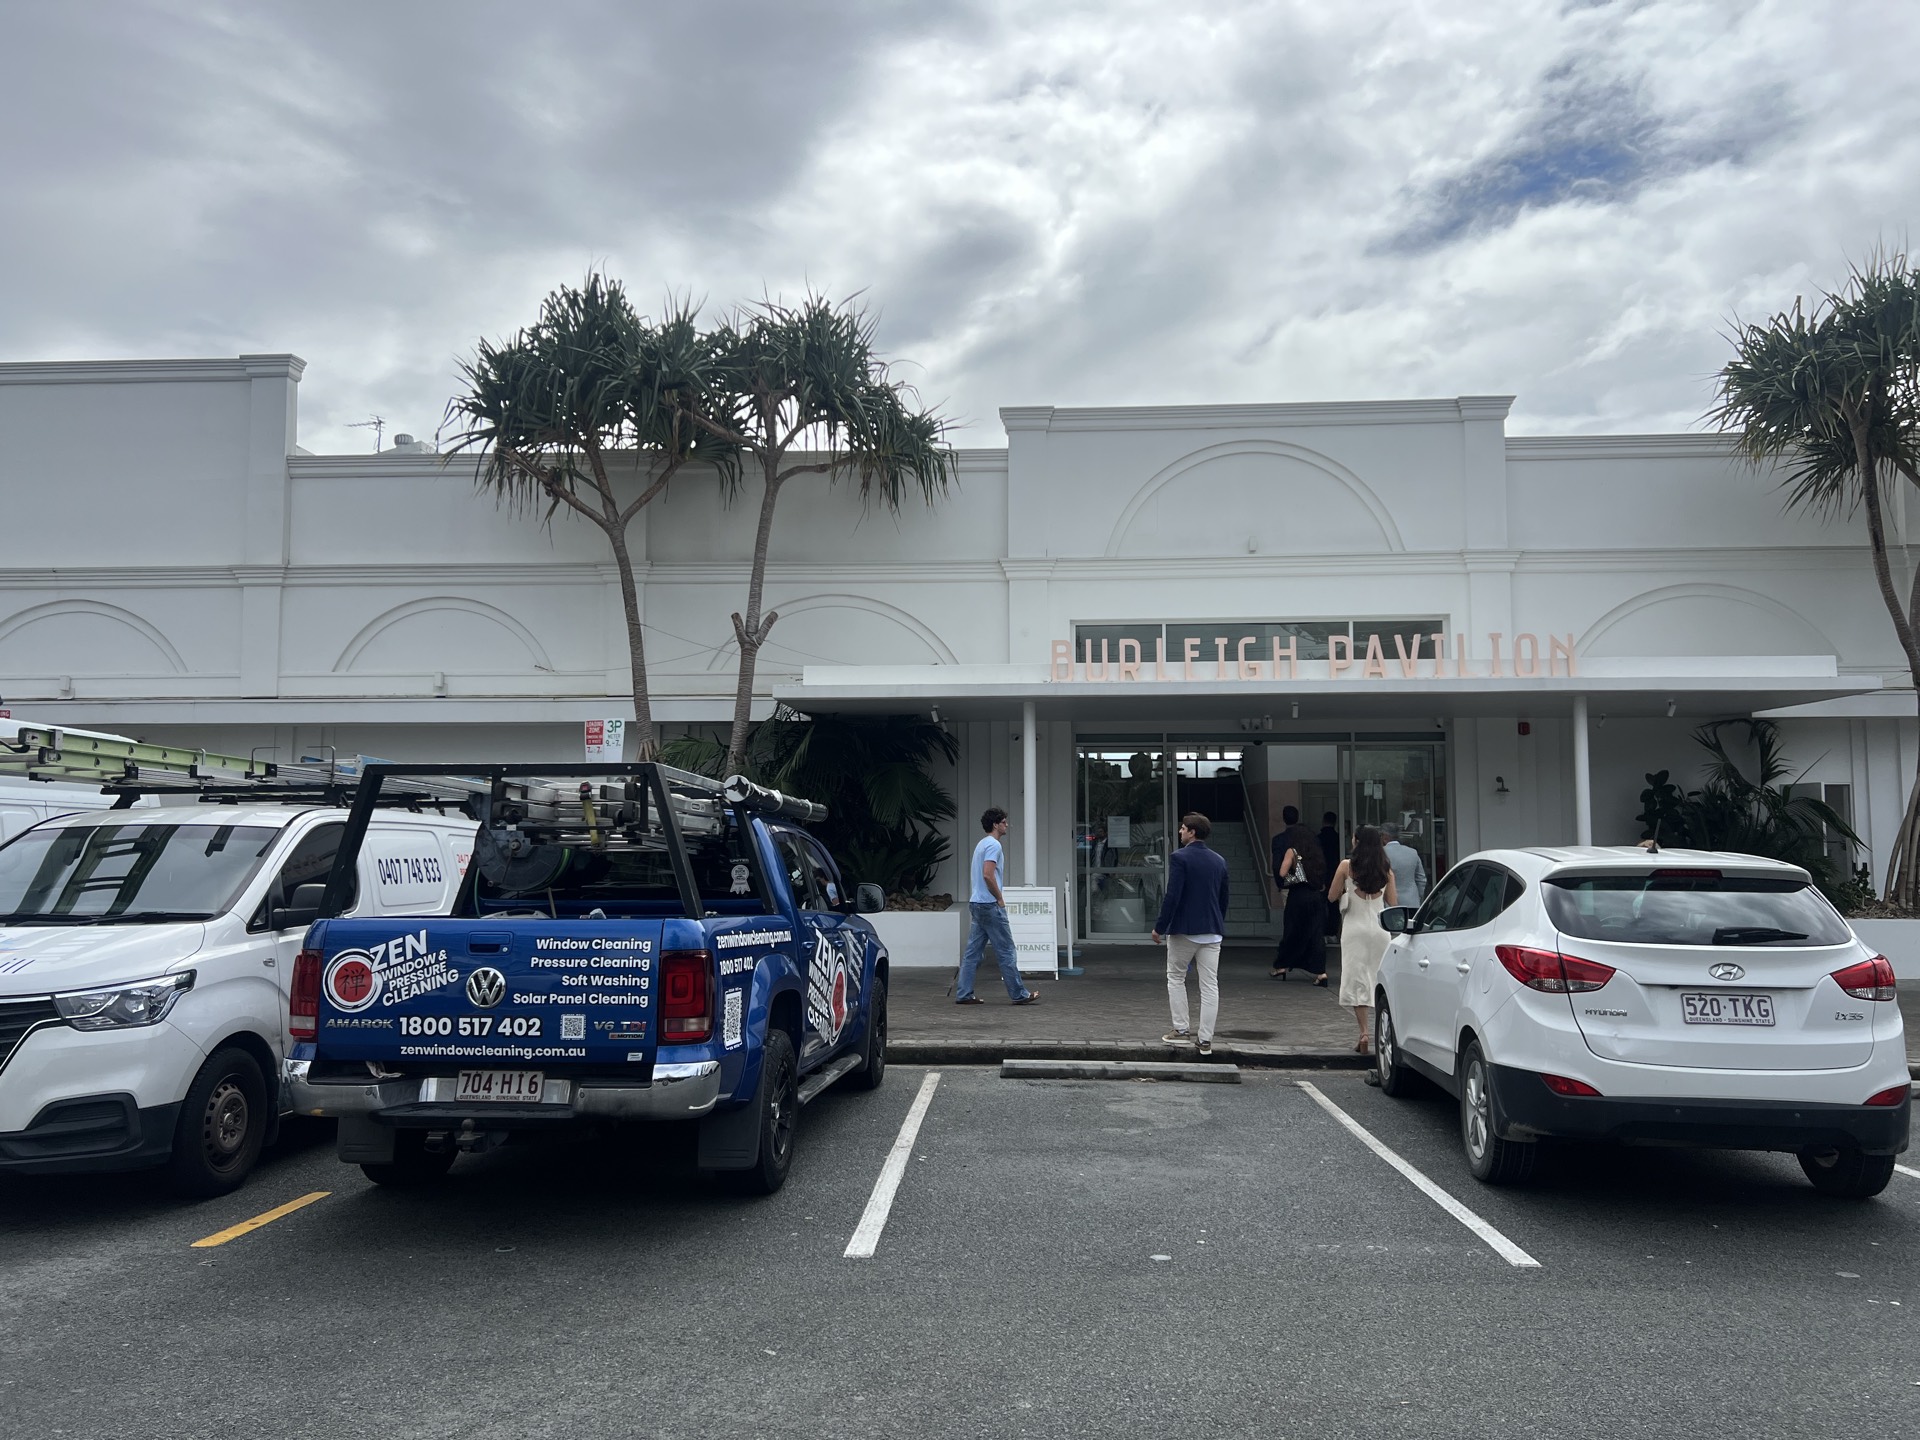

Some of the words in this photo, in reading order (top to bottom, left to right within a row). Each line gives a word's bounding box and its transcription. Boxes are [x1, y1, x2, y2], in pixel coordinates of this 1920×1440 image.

[1051, 636, 1297, 682] BURLEIGH
[1328, 632, 1576, 679] PAVILION
[607, 720, 622, 733] 3P
[378, 858, 403, 885] 0407
[404, 858, 424, 884] 748
[423, 858, 442, 883] 833
[536, 938, 590, 950] Window
[591, 938, 652, 953] Cleaning
[716, 928, 792, 949] zenwindowcleaning.com.au
[369, 929, 427, 973] ZEN
[815, 928, 835, 983] ZEN
[381, 952, 437, 982] WINDOW
[438, 949, 448, 961] &
[530, 956, 588, 968] Pressure
[590, 956, 650, 971] Cleaning
[719, 959, 734, 976] 1800
[734, 957, 743, 973] 517
[743, 956, 754, 970] 402
[389, 962, 447, 991] PRESSURE
[561, 974, 588, 986] Soft
[590, 974, 649, 989] Washing
[382, 969, 459, 1007] CLEANING
[513, 993, 547, 1004] Solar
[549, 993, 586, 1004] Panel
[588, 992, 649, 1007] Cleaning
[1584, 1007, 1628, 1017] HYUNDAI
[324, 1018, 394, 1029] AMAROK
[399, 1016, 452, 1036] 1800
[457, 1016, 493, 1036] 517
[497, 1017, 541, 1036] 402
[593, 1021, 615, 1031] V6
[620, 1021, 647, 1031] TDI
[400, 1044, 586, 1060] zenwindowcleaning.com.au
